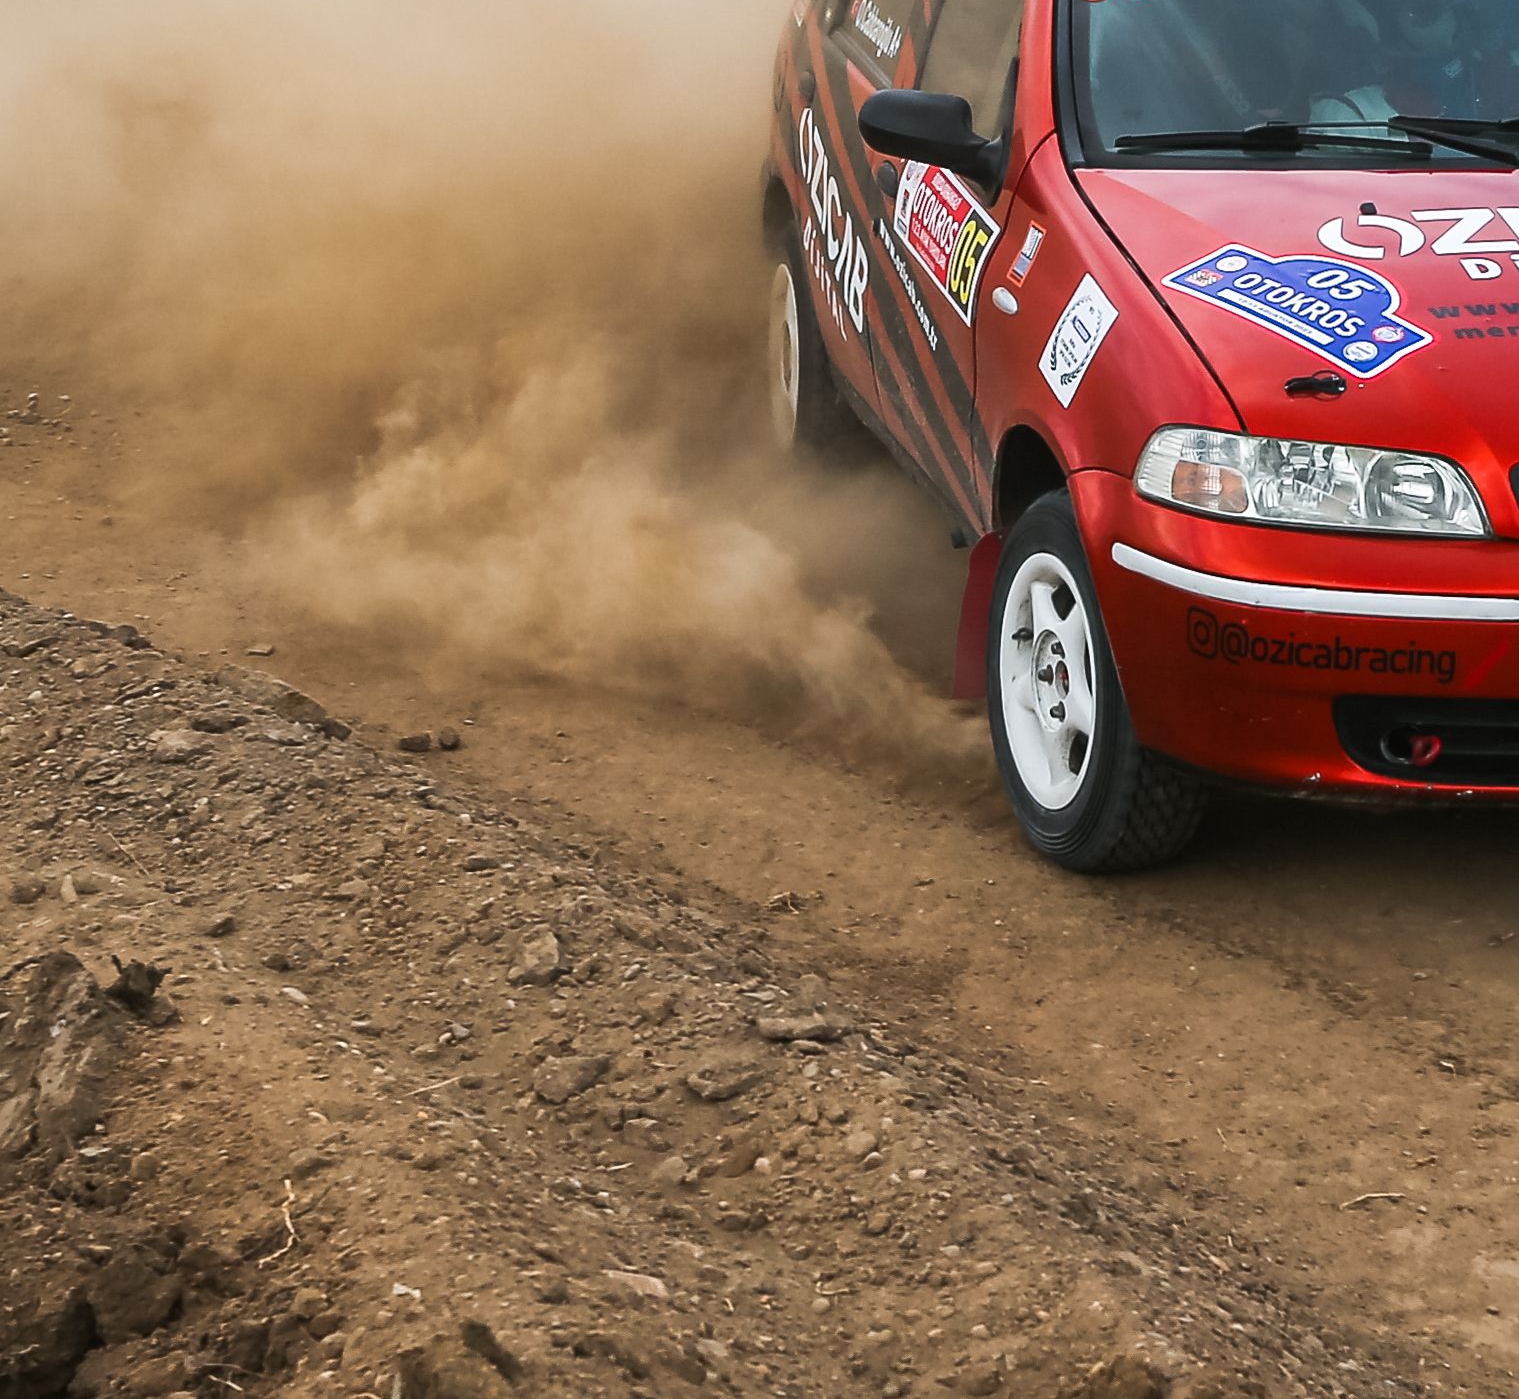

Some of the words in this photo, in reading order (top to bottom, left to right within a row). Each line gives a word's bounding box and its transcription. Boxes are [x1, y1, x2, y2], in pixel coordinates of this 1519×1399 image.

[799, 106, 869, 334] OZICAB
[913, 182, 959, 255] OTOKROS
[950, 219, 989, 305] 05
[1306, 268, 1377, 301] 05
[1232, 272, 1366, 337] OTOKROS
[1220, 621, 1457, 685] @ozicabracing
